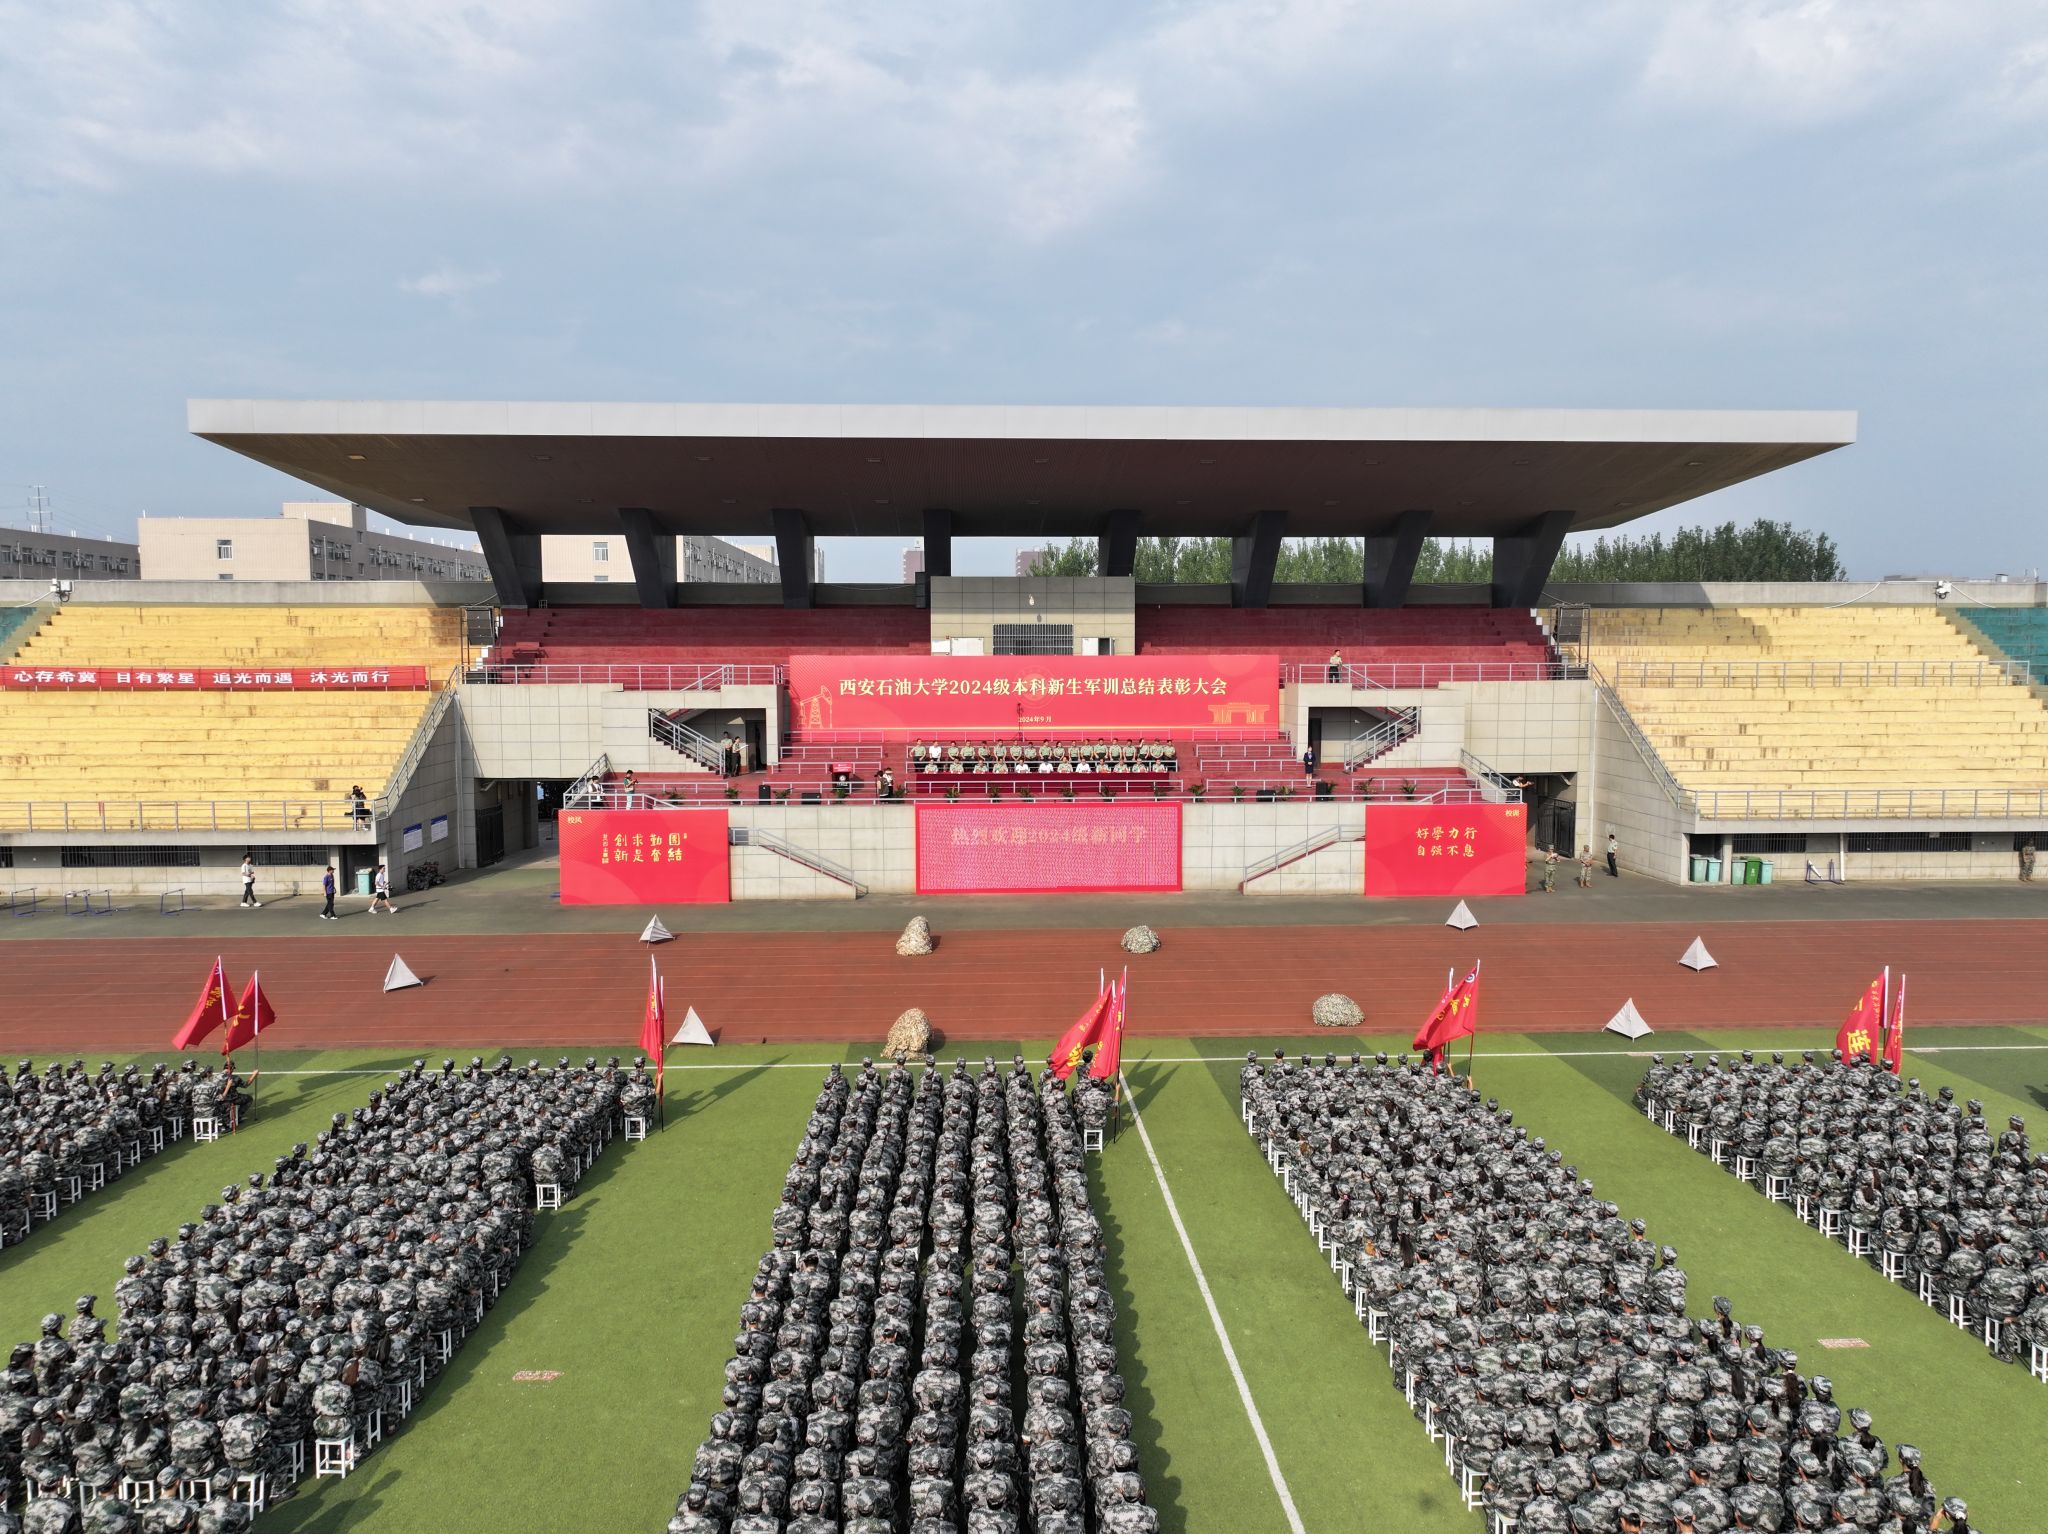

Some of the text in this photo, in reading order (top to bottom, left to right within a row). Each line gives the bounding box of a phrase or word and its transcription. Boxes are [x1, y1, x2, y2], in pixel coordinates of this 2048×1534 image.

[14, 671, 390, 684] 心存希冀 目有繁星 追光而遇 沐光而行
[839, 677, 1227, 696] 西安石油大学2024级本科新生军训总结表彰大会
